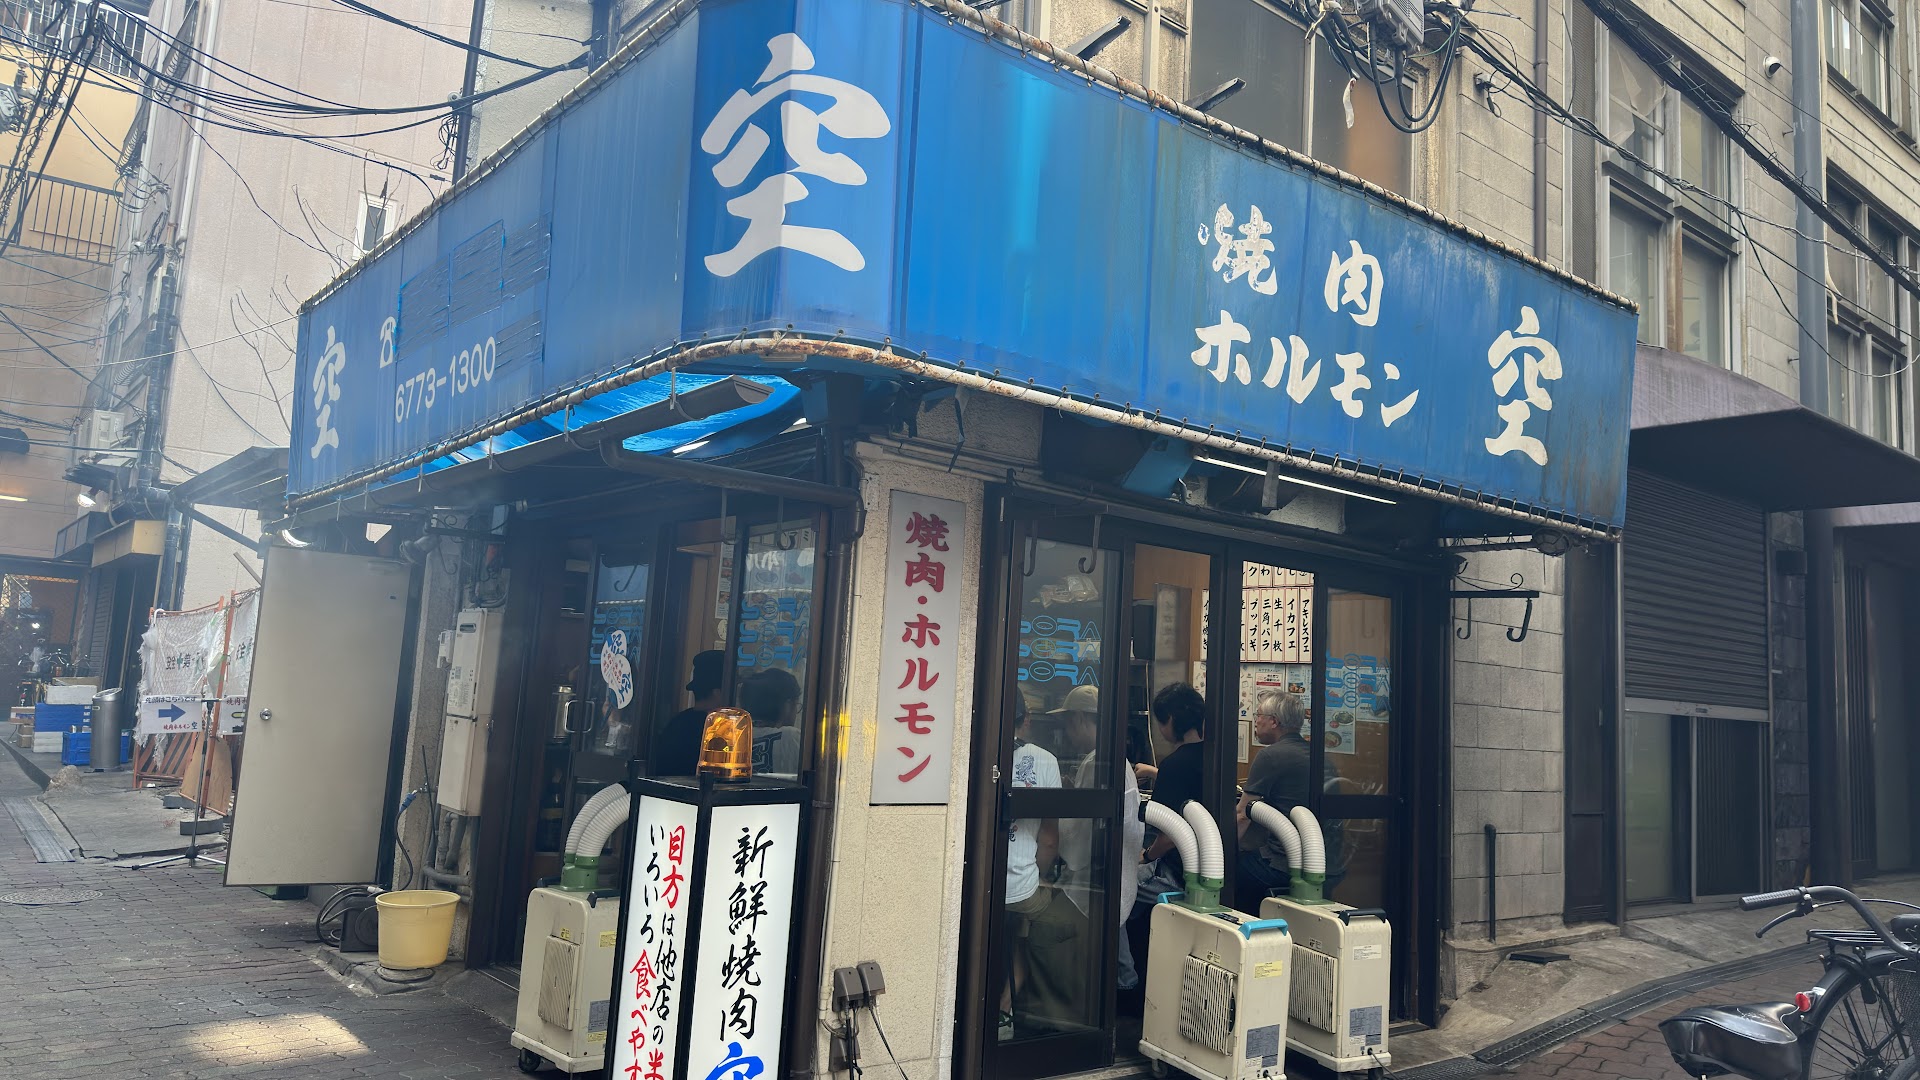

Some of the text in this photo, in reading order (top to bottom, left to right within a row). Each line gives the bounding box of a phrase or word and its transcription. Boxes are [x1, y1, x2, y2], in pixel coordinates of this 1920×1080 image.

[701, 32, 891, 277] 空
[1197, 202, 1384, 327] 焼肉
[311, 325, 346, 460] 空
[395, 336, 496, 424] 6773-1300
[1190, 309, 1419, 428] ホルモン
[1484, 305, 1563, 466] 空
